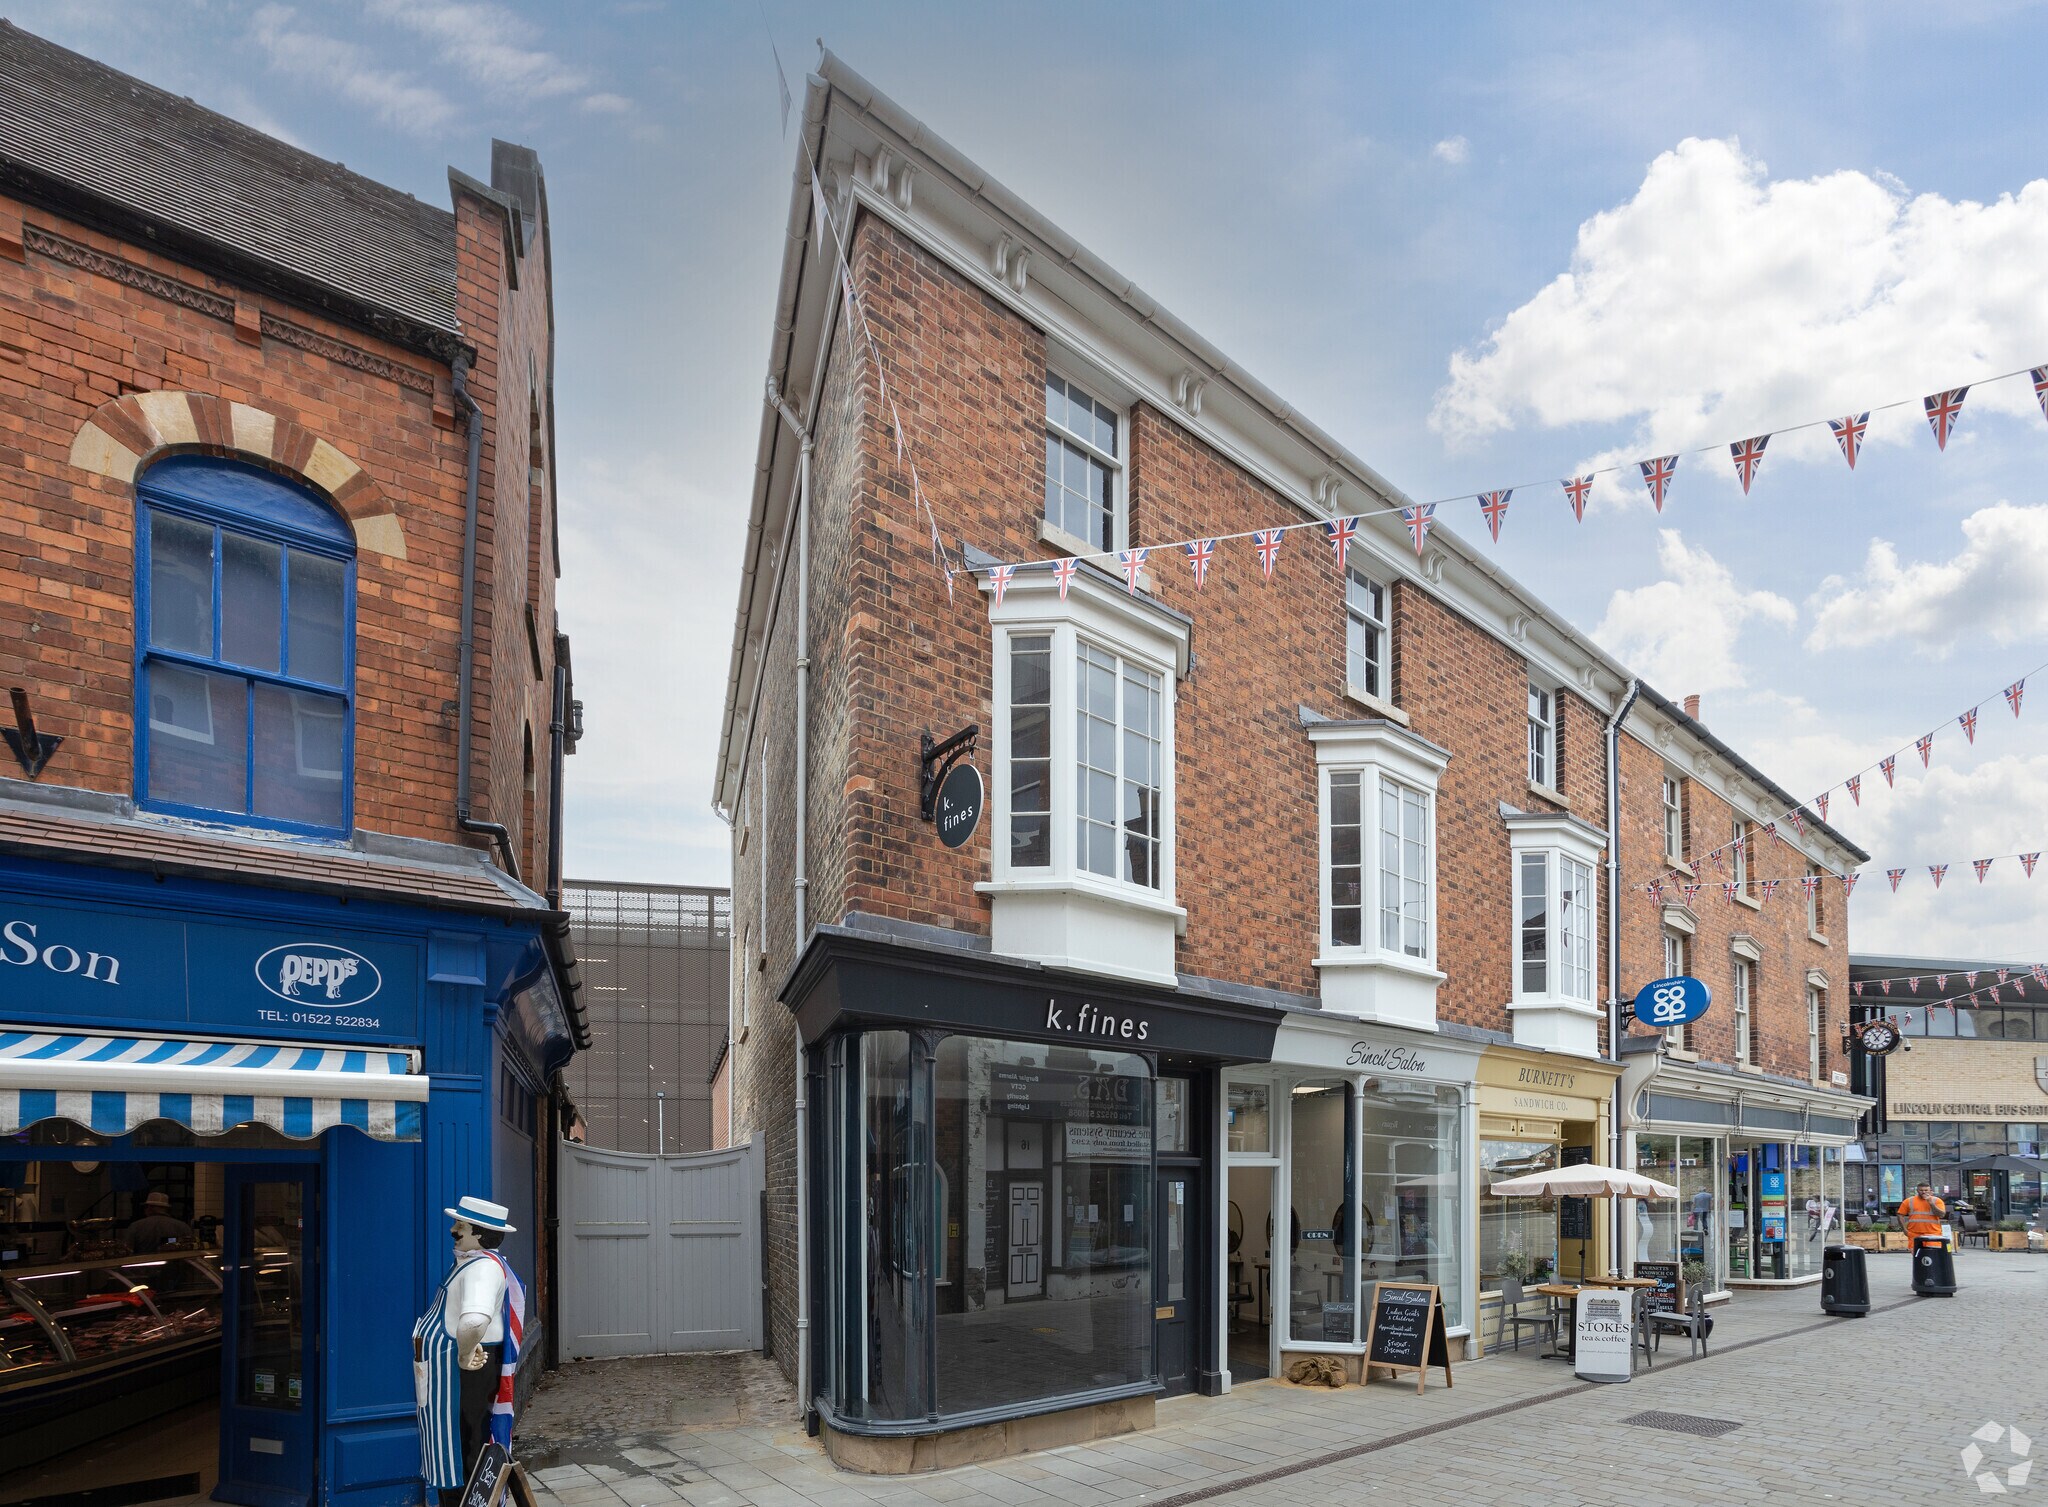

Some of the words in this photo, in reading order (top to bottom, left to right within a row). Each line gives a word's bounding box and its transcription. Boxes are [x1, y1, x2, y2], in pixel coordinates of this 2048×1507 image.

[943, 805, 973, 831] fines
[0, 920, 120, 985] Son
[1652, 979, 1686, 989] Lincolnshire
[257, 1009, 288, 1021] TEL:
[292, 1012, 331, 1025] 01522
[335, 1015, 380, 1028] 522834
[1046, 998, 1149, 1040] k.fines
[1345, 1040, 1392, 1067] Sincil
[1386, 1047, 1426, 1072] Salon
[1518, 1067, 1575, 1089] BURNETT'S
[1513, 1096, 1554, 1110] SANDWICH
[1556, 1100, 1569, 1111] CO.
[1893, 1102, 1941, 1115] LINCOLN
[1943, 1103, 1993, 1116] CENTRAL
[1995, 1103, 2018, 1116] BUS
[1577, 1321, 1630, 1334] STOKES
